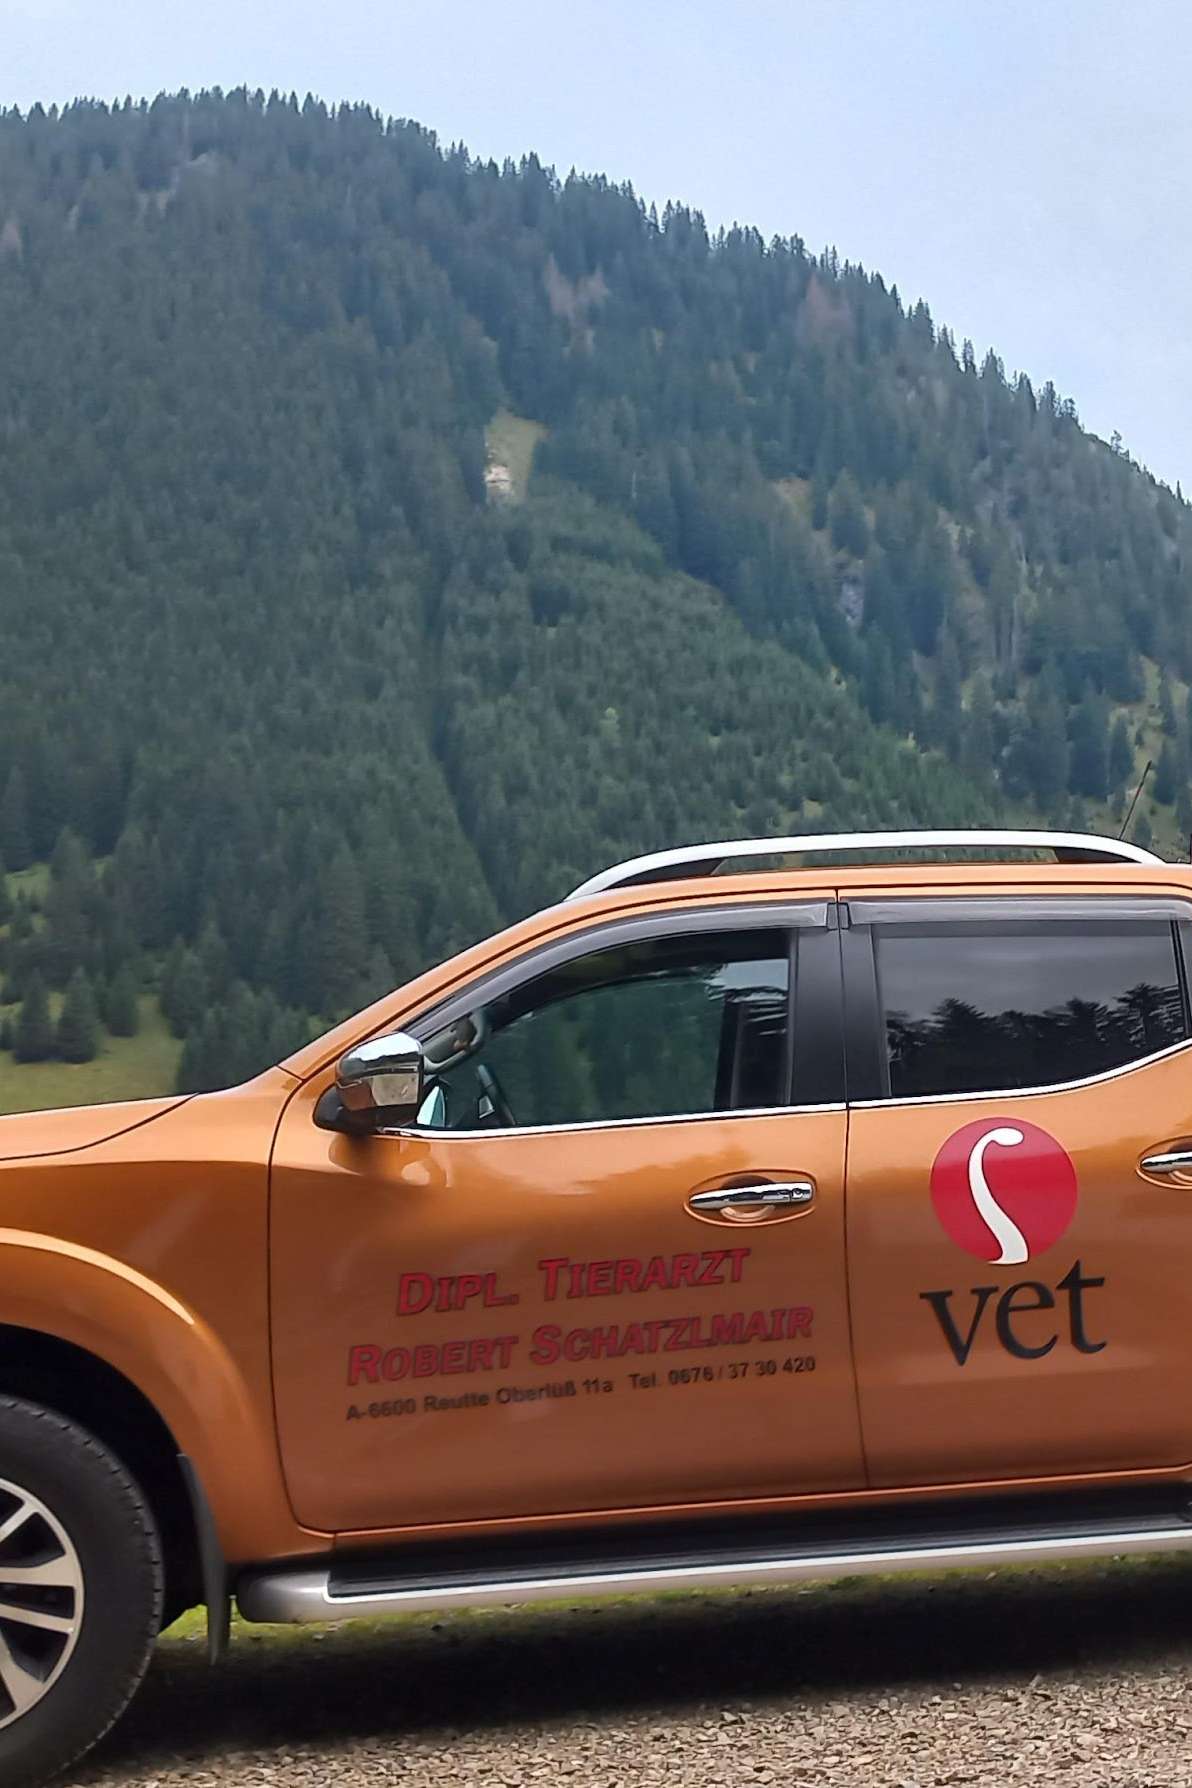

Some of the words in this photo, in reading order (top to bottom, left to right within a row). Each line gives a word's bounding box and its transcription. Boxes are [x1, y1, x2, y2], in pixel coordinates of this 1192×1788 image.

[919, 1258, 1108, 1367] vet
[346, 1335, 520, 1386] ROBERT
[782, 1355, 816, 1374] 420
